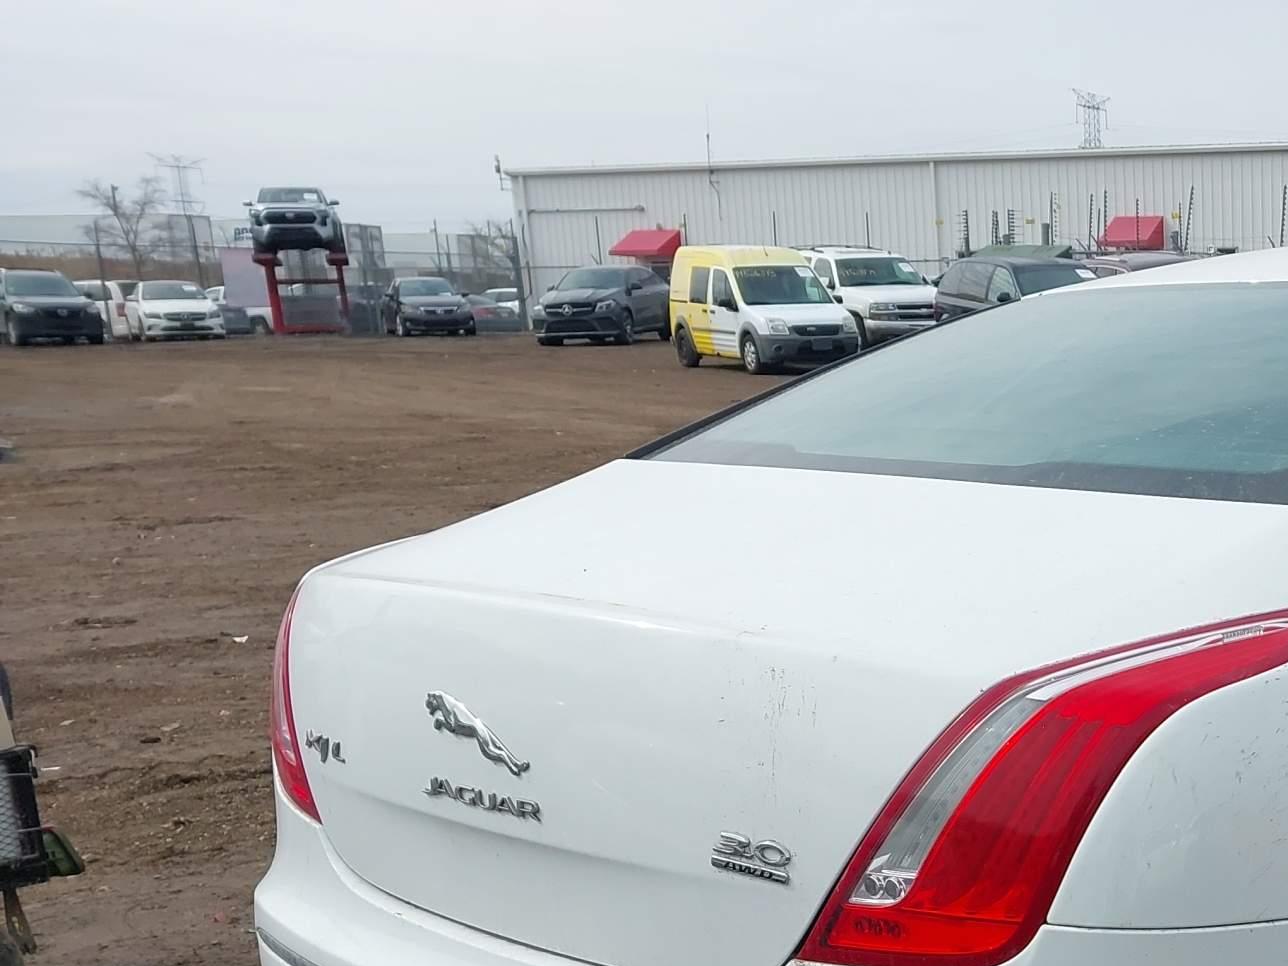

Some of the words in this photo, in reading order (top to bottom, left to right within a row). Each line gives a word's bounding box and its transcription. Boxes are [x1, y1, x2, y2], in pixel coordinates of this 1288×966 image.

[422, 776, 542, 823] JAGUAR
[712, 831, 792, 868] 3.0
[723, 861, 774, 880] AWD
